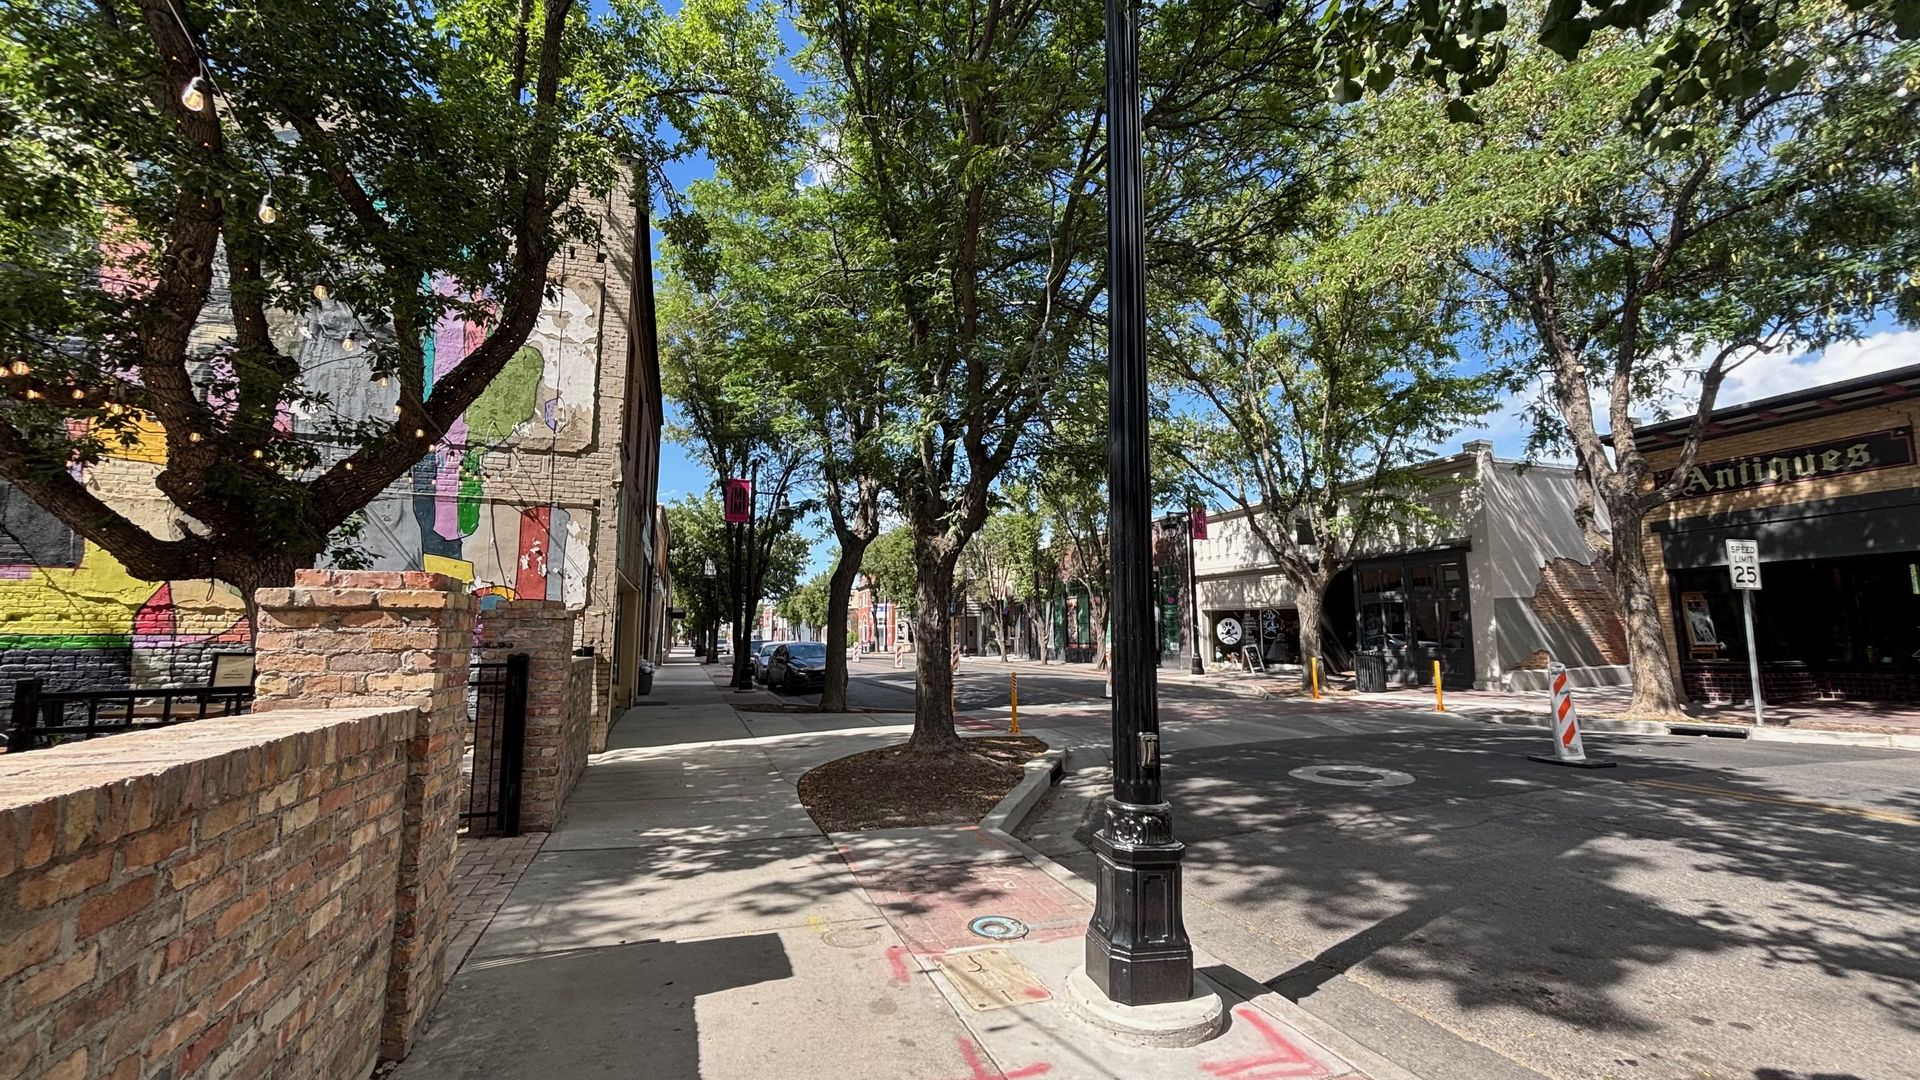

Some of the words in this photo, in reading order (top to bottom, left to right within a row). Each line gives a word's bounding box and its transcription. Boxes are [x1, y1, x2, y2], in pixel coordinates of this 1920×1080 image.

[1682, 443, 1872, 497] Antiques
[1730, 545, 1756, 554] SPEED
[1734, 555, 1754, 563] LIMIT
[1734, 566, 1757, 583] 25
